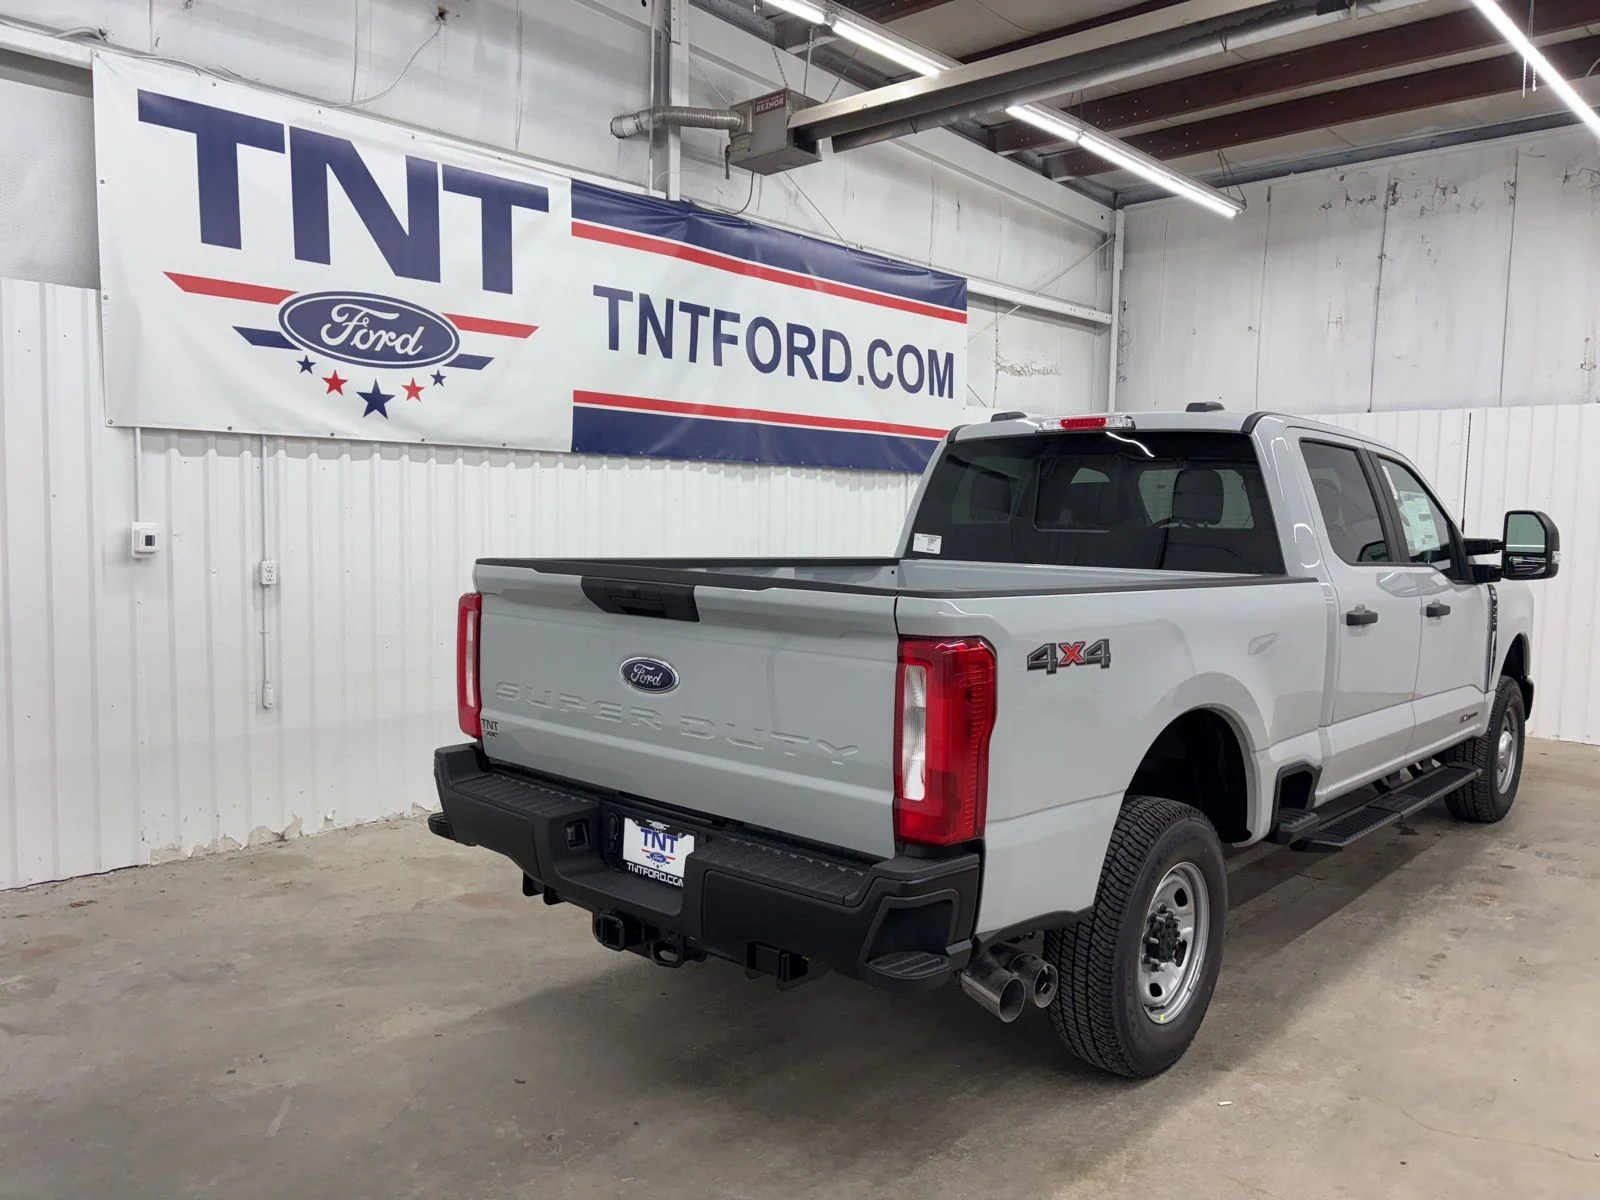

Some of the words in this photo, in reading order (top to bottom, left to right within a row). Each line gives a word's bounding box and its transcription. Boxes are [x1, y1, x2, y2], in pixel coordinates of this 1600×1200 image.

[137, 88, 549, 294] TNT
[320, 303, 424, 356] Ford
[593, 285, 954, 399] TNTFORD.COM
[631, 663, 662, 686] Ford
[480, 718, 499, 731] TNT
[496, 681, 662, 731] SUPER
[680, 714, 859, 765] DUTY
[640, 828, 678, 854] TNT
